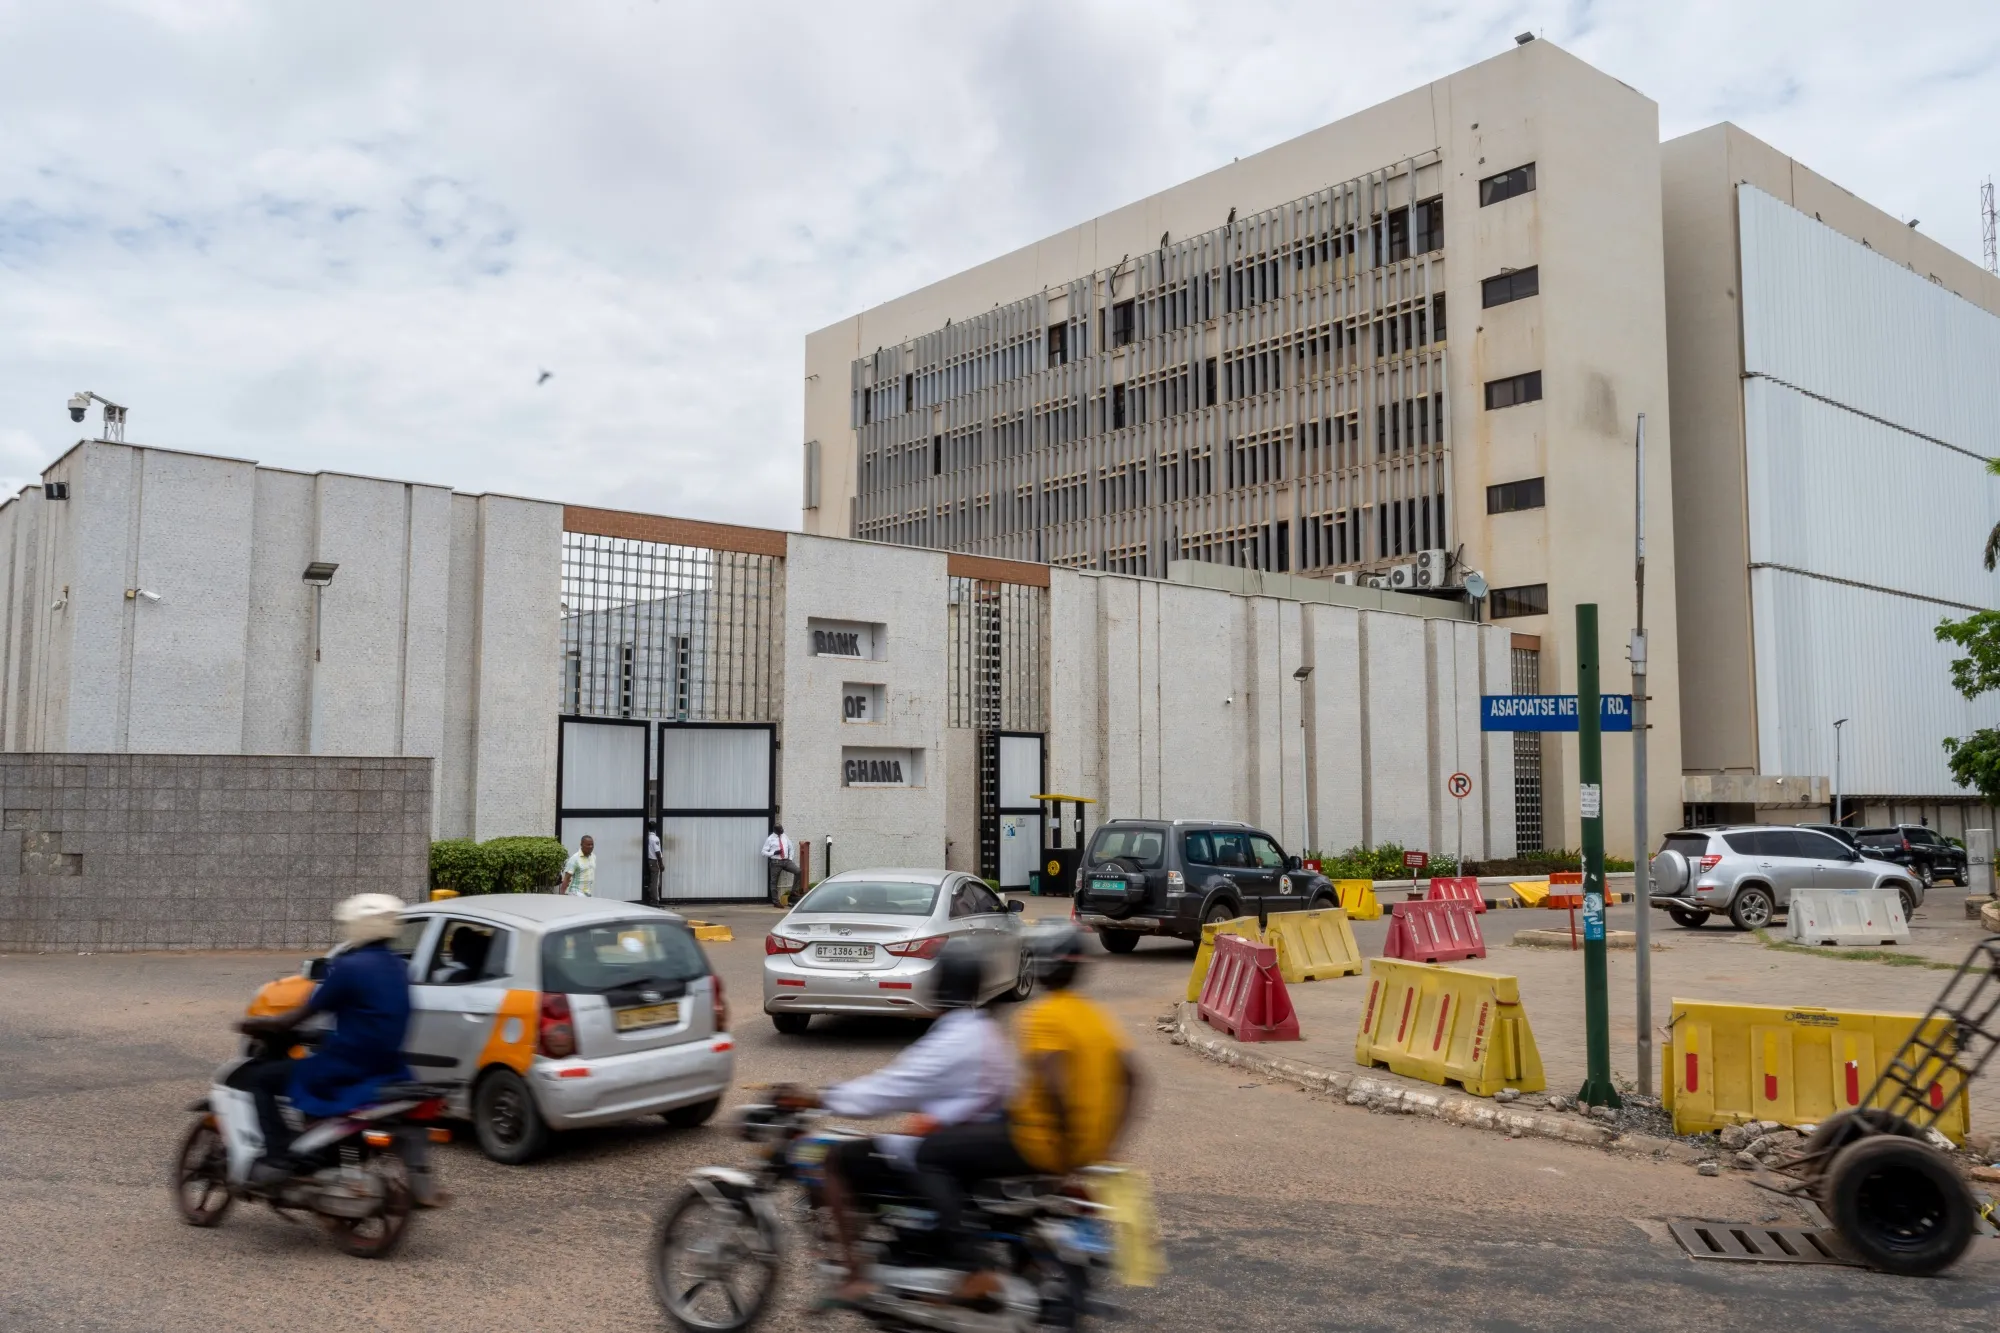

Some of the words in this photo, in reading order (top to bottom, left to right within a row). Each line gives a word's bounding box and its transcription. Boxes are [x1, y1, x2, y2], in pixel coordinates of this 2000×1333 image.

[814, 630, 860, 656] BANK
[844, 696, 866, 719] OF
[1490, 698, 1556, 716] ASAFOATSE
[1558, 697, 1604, 715] NETY
[1607, 697, 1629, 715] RD.
[844, 759, 903, 783] GHANA
[1455, 777, 1466, 793] P
[817, 946, 828, 955] GT
